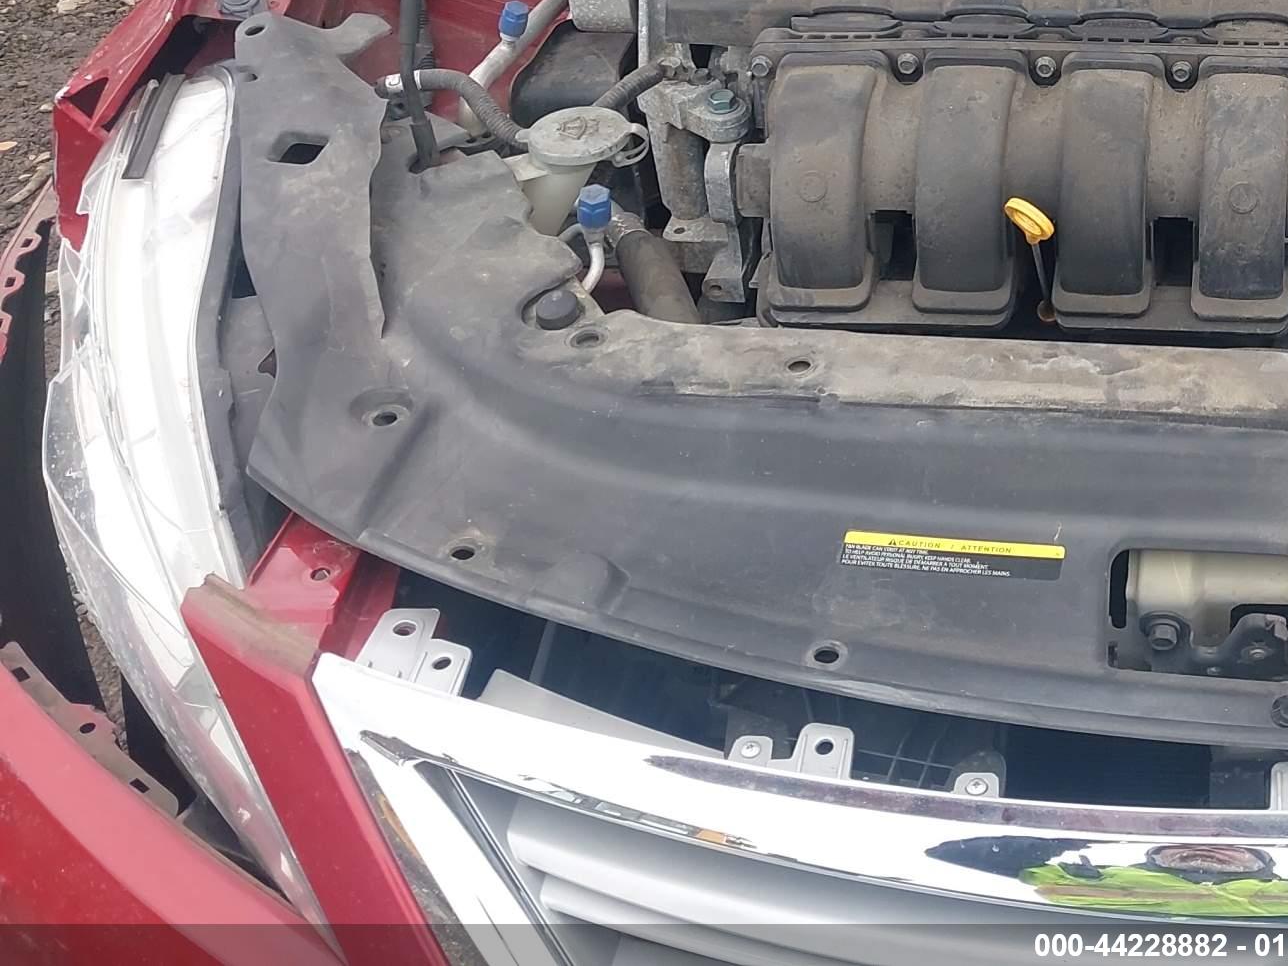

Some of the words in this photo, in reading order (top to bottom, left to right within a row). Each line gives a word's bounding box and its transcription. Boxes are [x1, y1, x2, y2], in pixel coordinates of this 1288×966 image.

[898, 540, 941, 548] CAUTION
[960, 545, 1012, 553] ATTENTION
[850, 554, 884, 562] VENTILATEUR
